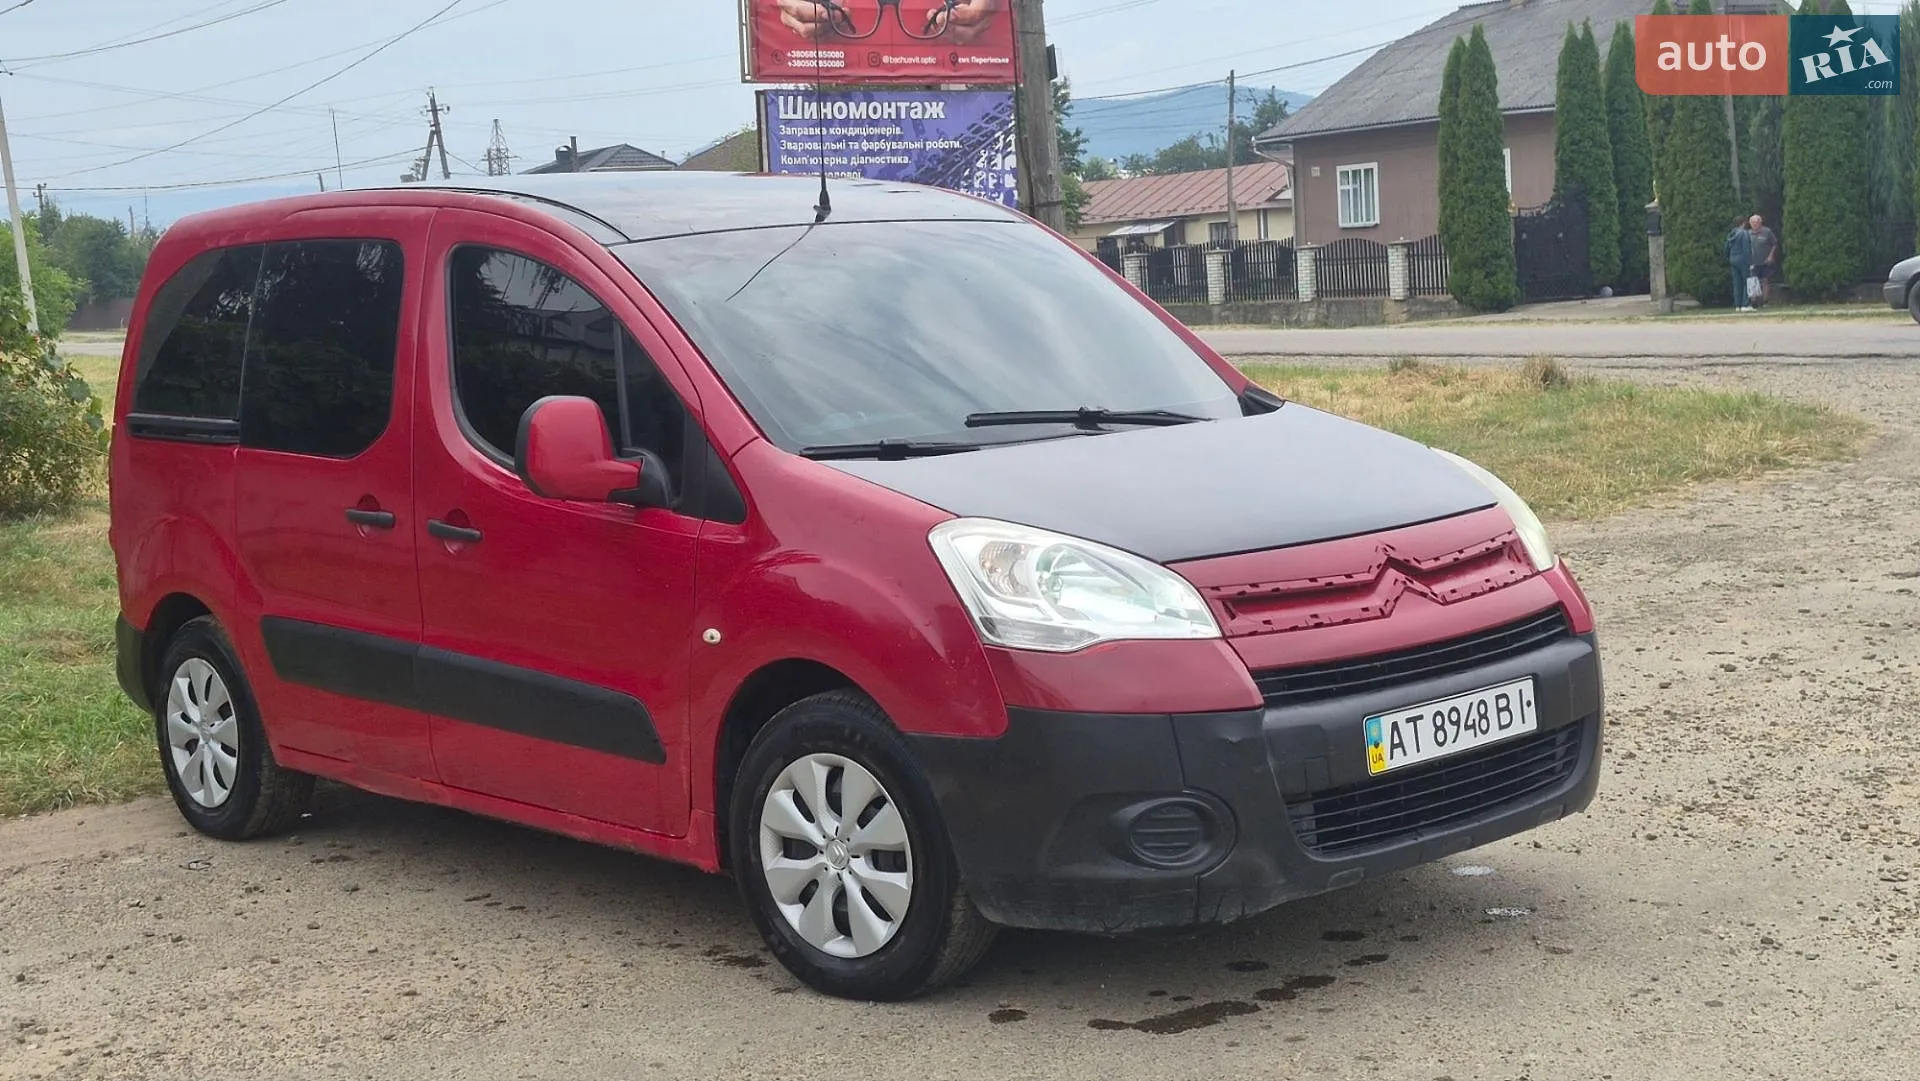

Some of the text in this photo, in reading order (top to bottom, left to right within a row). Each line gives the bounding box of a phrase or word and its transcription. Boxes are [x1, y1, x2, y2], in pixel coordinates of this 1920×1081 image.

[778, 96, 945, 119] Шиномонтаж
[779, 125, 904, 137] Заправка кондиціонерів.
[849, 141, 860, 150] та
[861, 139, 923, 152] фарбувальні
[926, 139, 963, 150] роботи.
[850, 154, 912, 166] діагностика.
[1389, 689, 1526, 760] AT 8948 BI
[1372, 754, 1385, 764] UA
